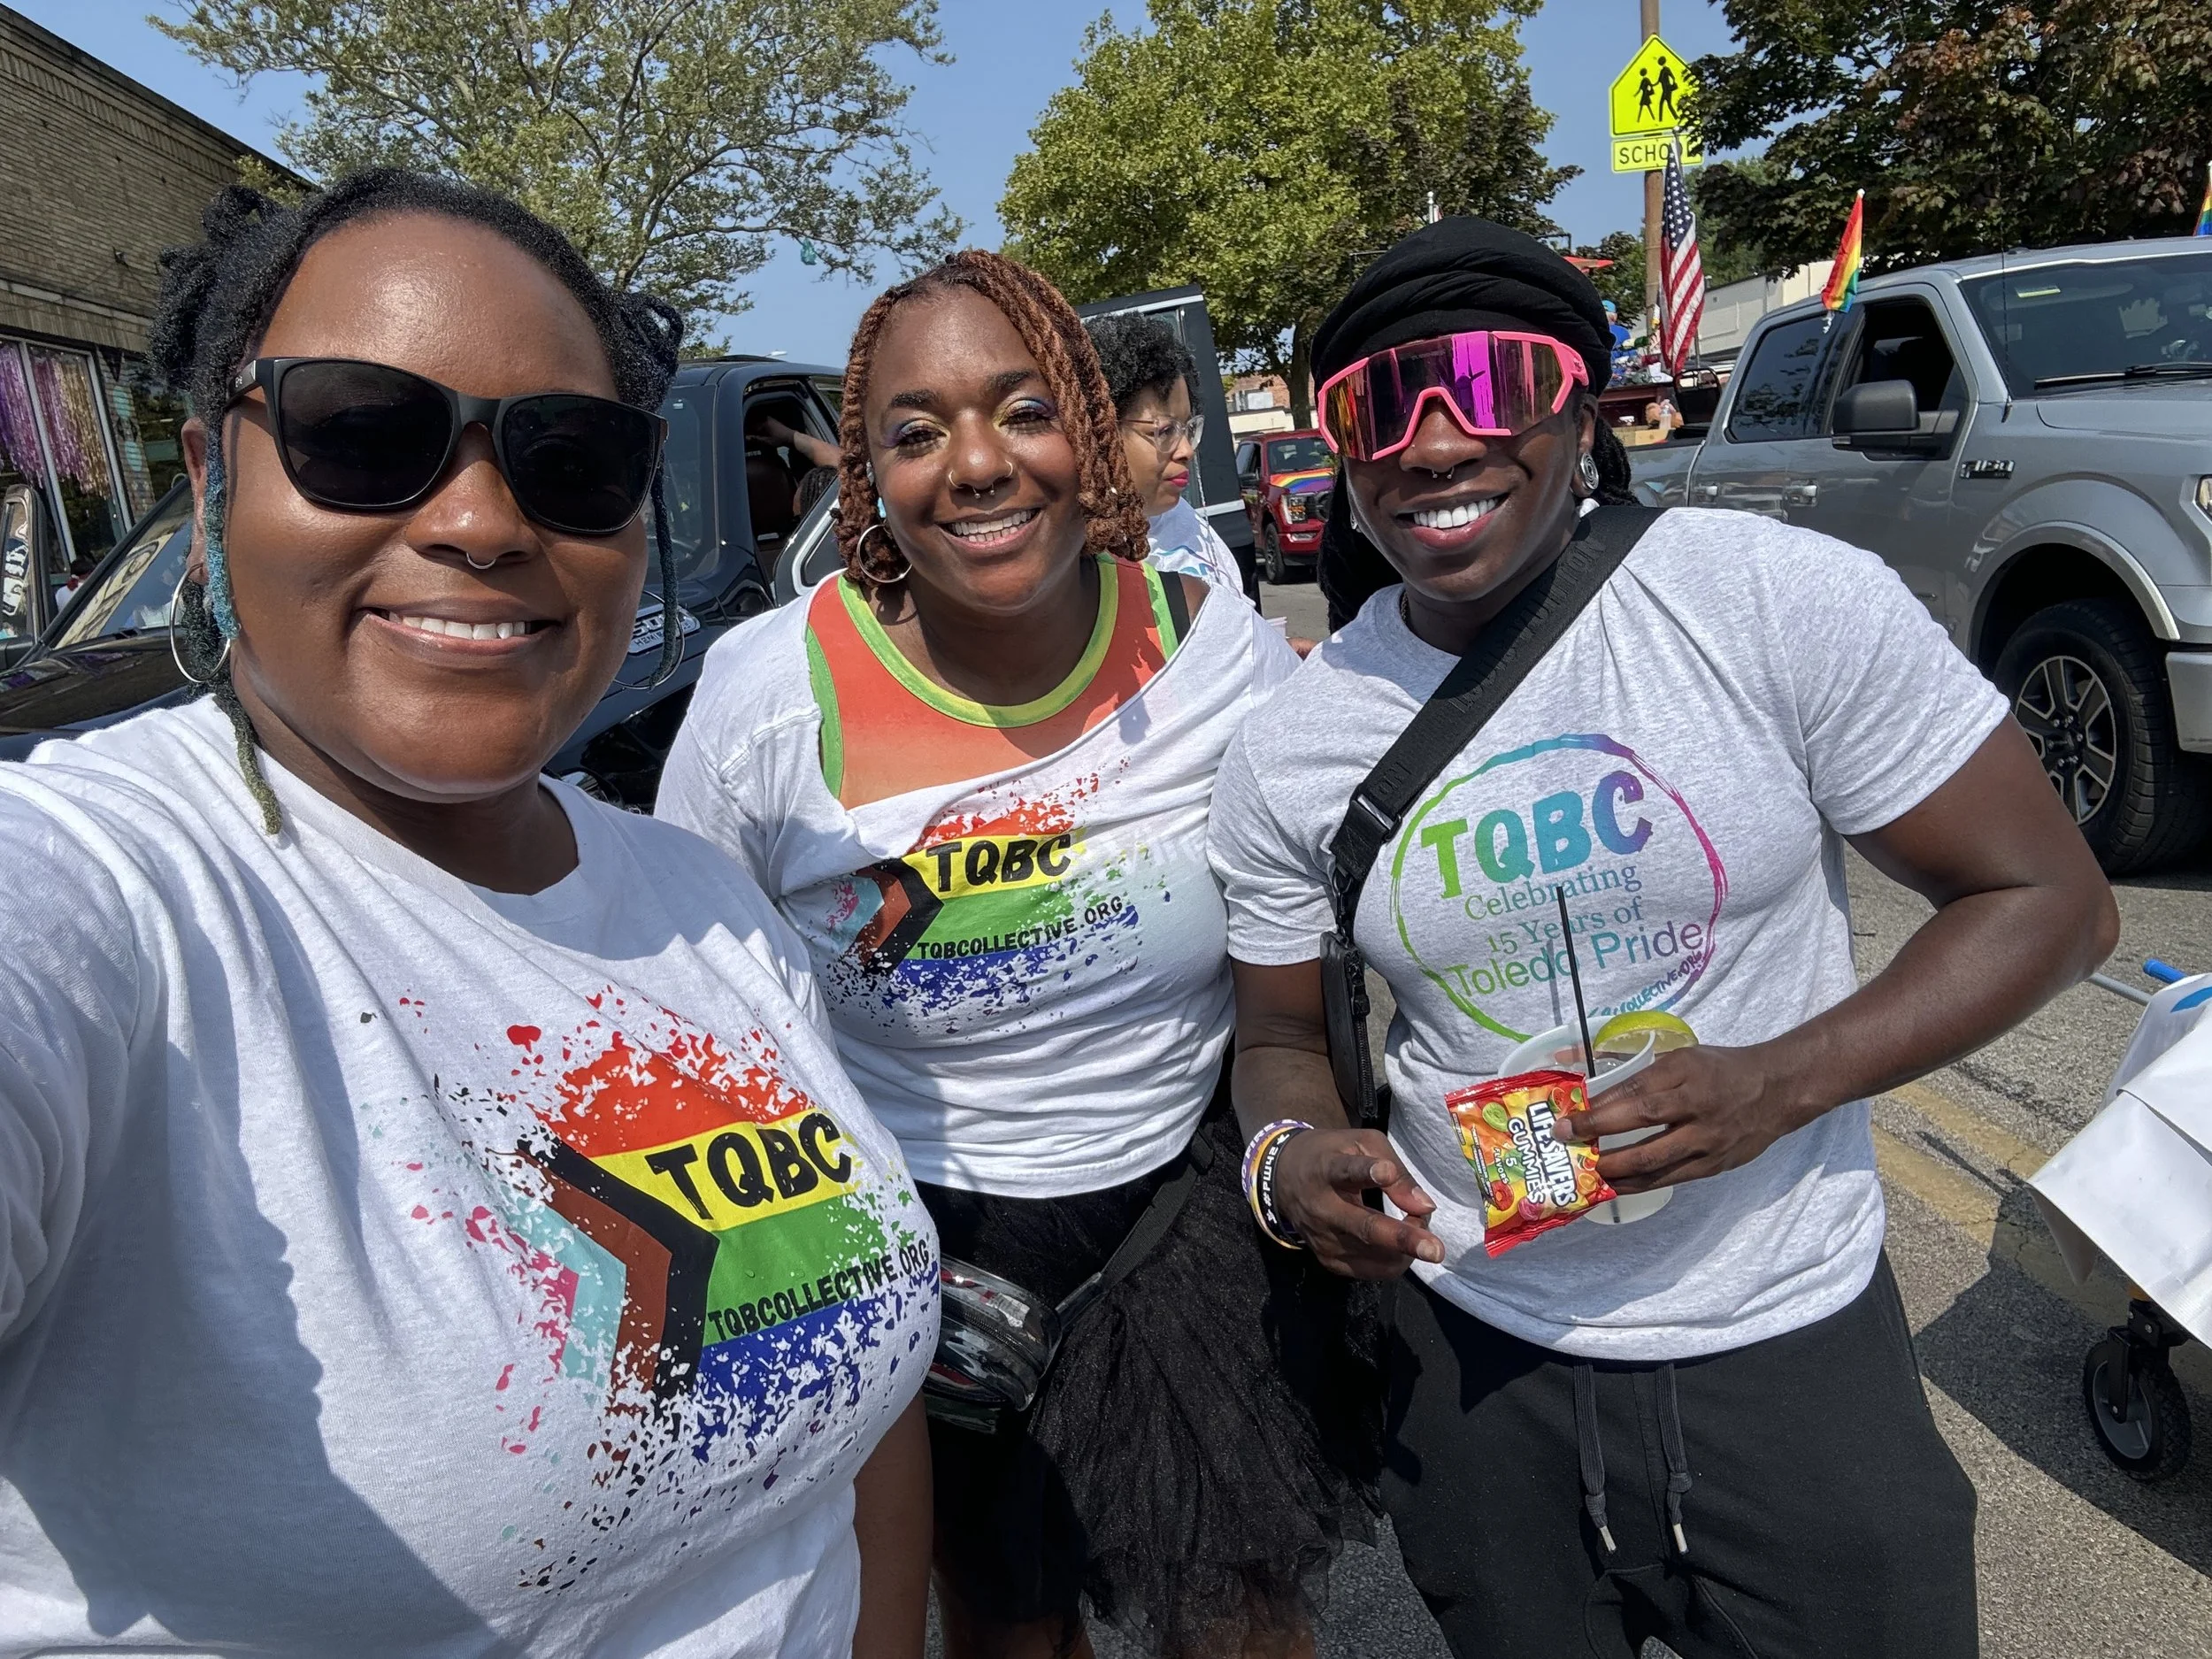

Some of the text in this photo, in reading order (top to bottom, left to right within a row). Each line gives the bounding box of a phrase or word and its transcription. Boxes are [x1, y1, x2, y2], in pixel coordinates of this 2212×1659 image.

[1619, 140, 1696, 165] SCHOL
[926, 833, 1072, 892] TQBC
[1421, 770, 1654, 899] TQBC
[1464, 865, 1643, 920] Celebrating
[917, 896, 1123, 959] TQBCOLLECTIVE.ORG
[1487, 895, 1644, 955] 15 Yers of
[1445, 920, 1704, 998] Toledo Pride
[644, 1111, 852, 1221] TQBC
[1246, 1122, 1276, 1159] FIRE
[1494, 1147, 1509, 1185] FLAVORS
[1505, 1156, 1517, 1168] 5
[1508, 1118, 1545, 1204] GUMMIES
[708, 1240, 930, 1342] TQBCOLLECTIVE.ORG
